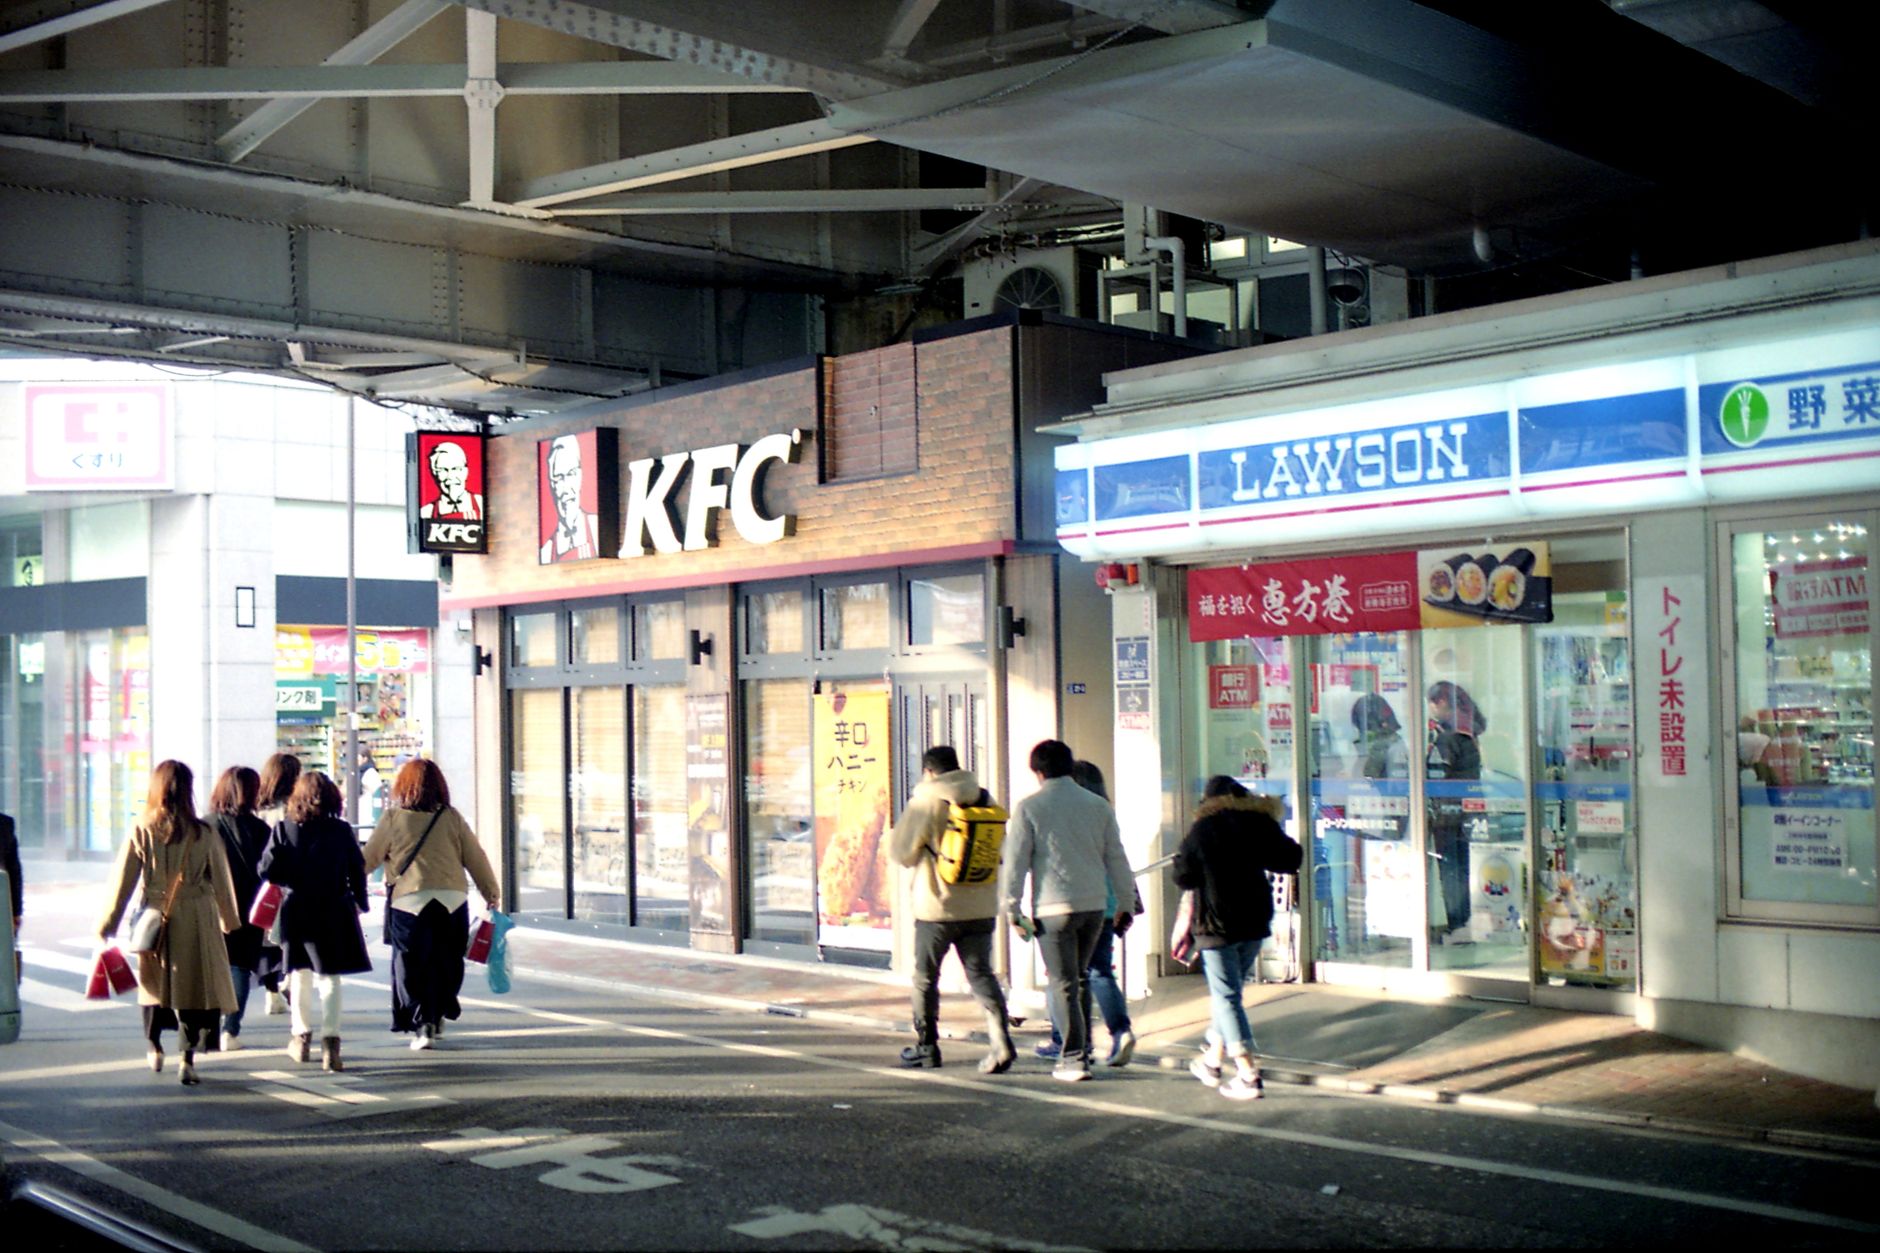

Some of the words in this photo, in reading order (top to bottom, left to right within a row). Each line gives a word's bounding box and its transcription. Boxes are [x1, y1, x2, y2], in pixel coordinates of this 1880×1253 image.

[1788, 376, 1880, 431] 野菜
[72, 453, 122, 469] くすり
[1231, 422, 1469, 501] LAWSON
[618, 431, 796, 559] KFC
[427, 523, 481, 544] KFC
[1198, 594, 1255, 616] 福を招く
[1261, 574, 1354, 626] 恵方巻
[1659, 586, 1686, 776] トイレ未設置
[1220, 690, 1249, 702] ATM
[835, 720, 867, 748] 辛口
[827, 754, 876, 770] ハニー
[838, 779, 867, 794] チキン
